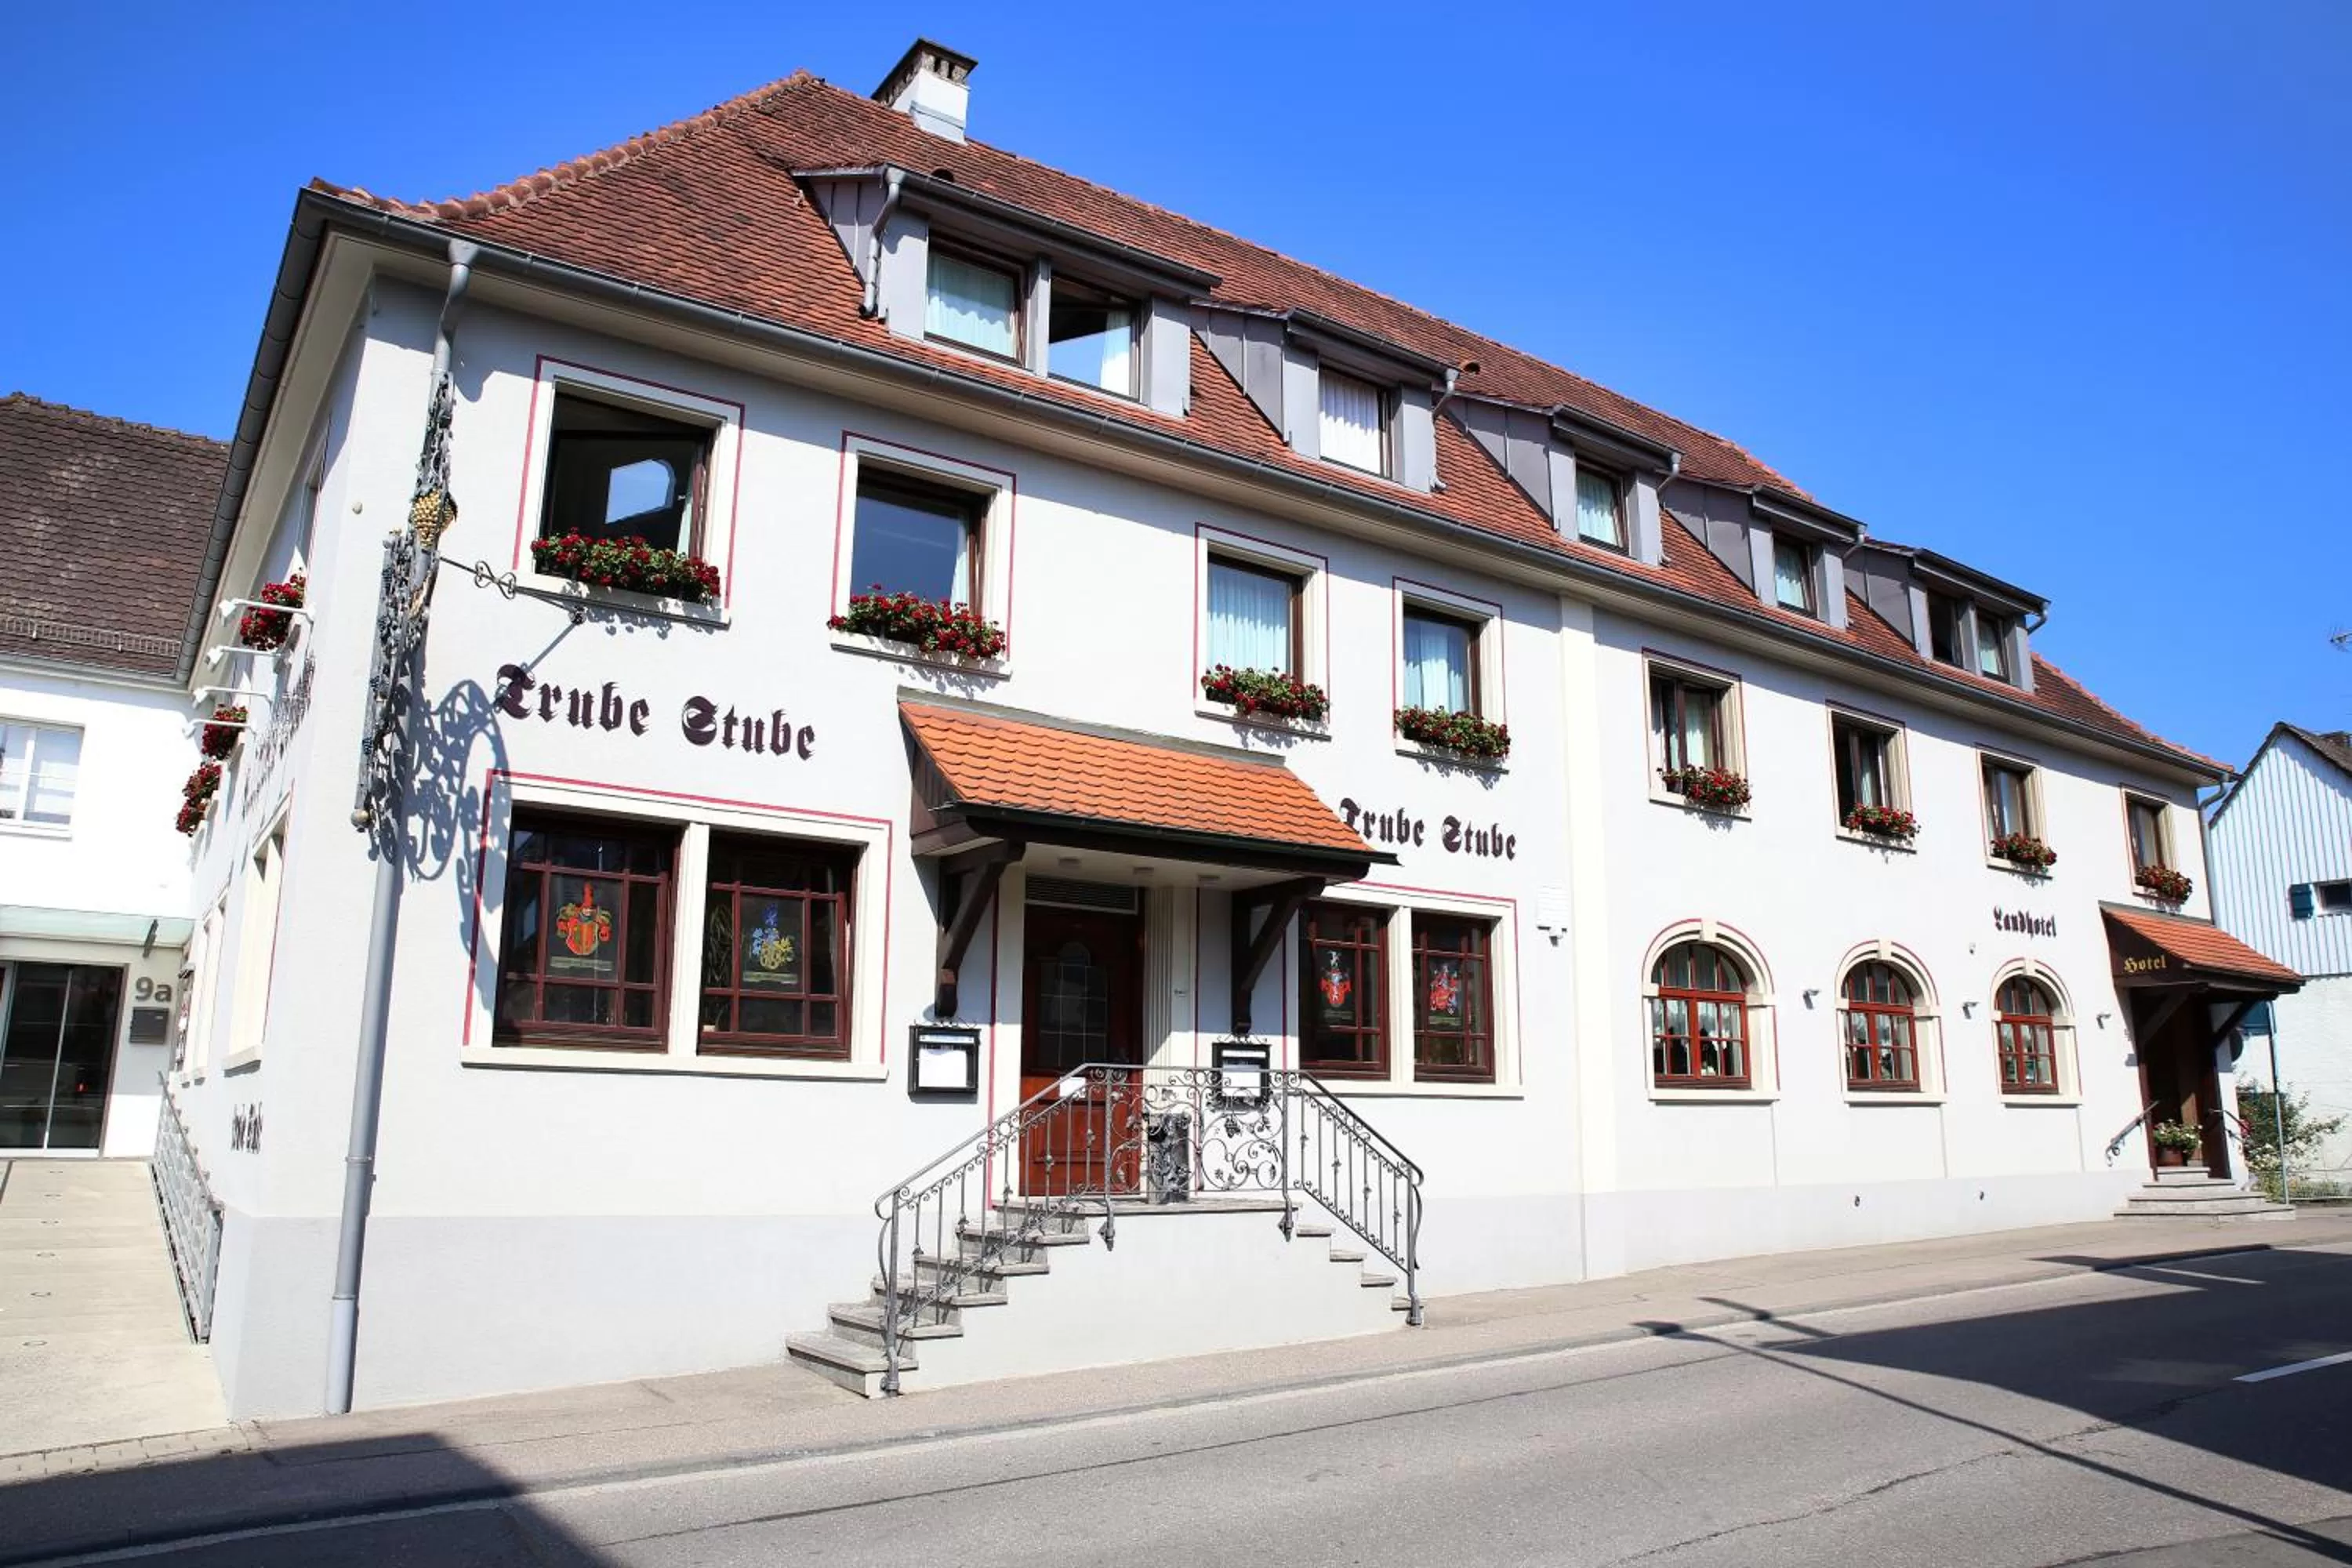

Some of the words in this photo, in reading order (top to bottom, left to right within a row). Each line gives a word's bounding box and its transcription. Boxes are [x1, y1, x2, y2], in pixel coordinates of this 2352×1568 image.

[681, 695, 815, 760] Stube
[1441, 815, 1517, 861] Stube
[1994, 906, 2057, 938] Landhotel
[2123, 954, 2167, 973] Hotel
[135, 976, 172, 1003] 9a
